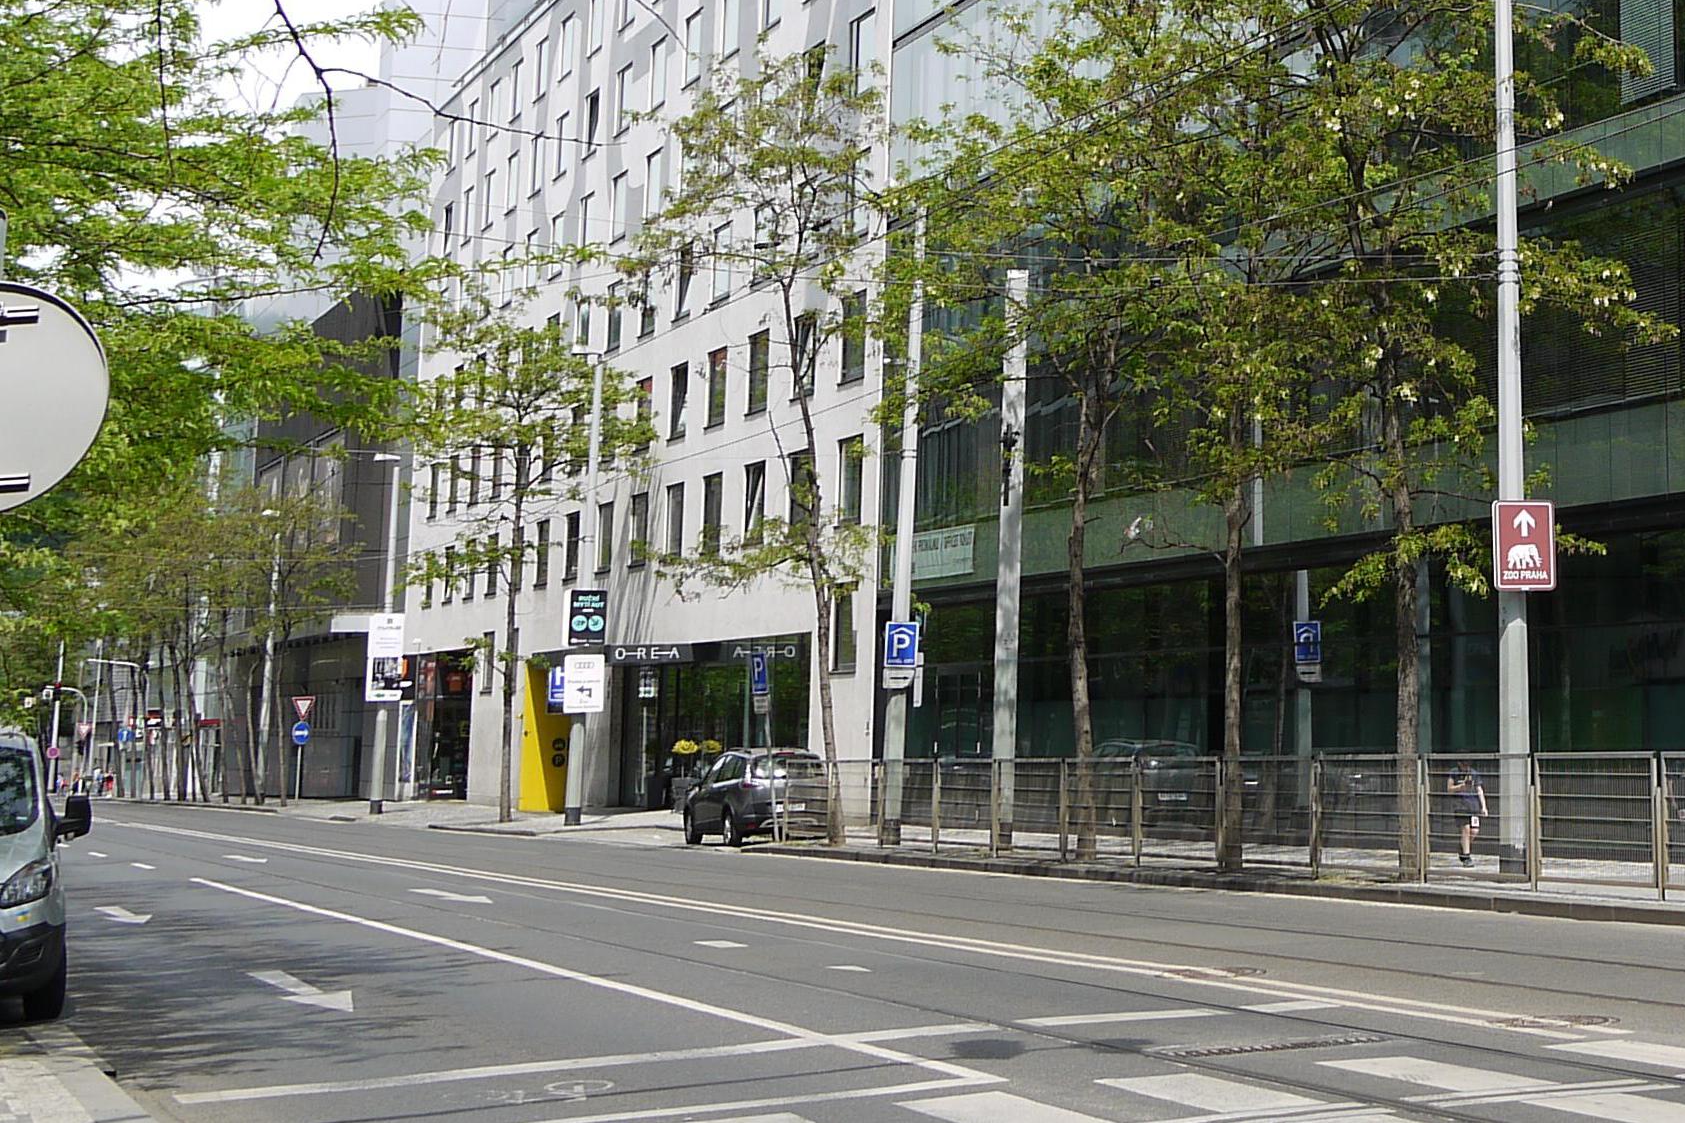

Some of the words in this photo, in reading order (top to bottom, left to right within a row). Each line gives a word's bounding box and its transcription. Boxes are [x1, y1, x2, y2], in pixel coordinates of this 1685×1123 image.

[1502, 570, 1520, 580] ZOO
[1520, 570, 1549, 580] PRAHA
[892, 633, 911, 658] P
[754, 657, 763, 681] P
